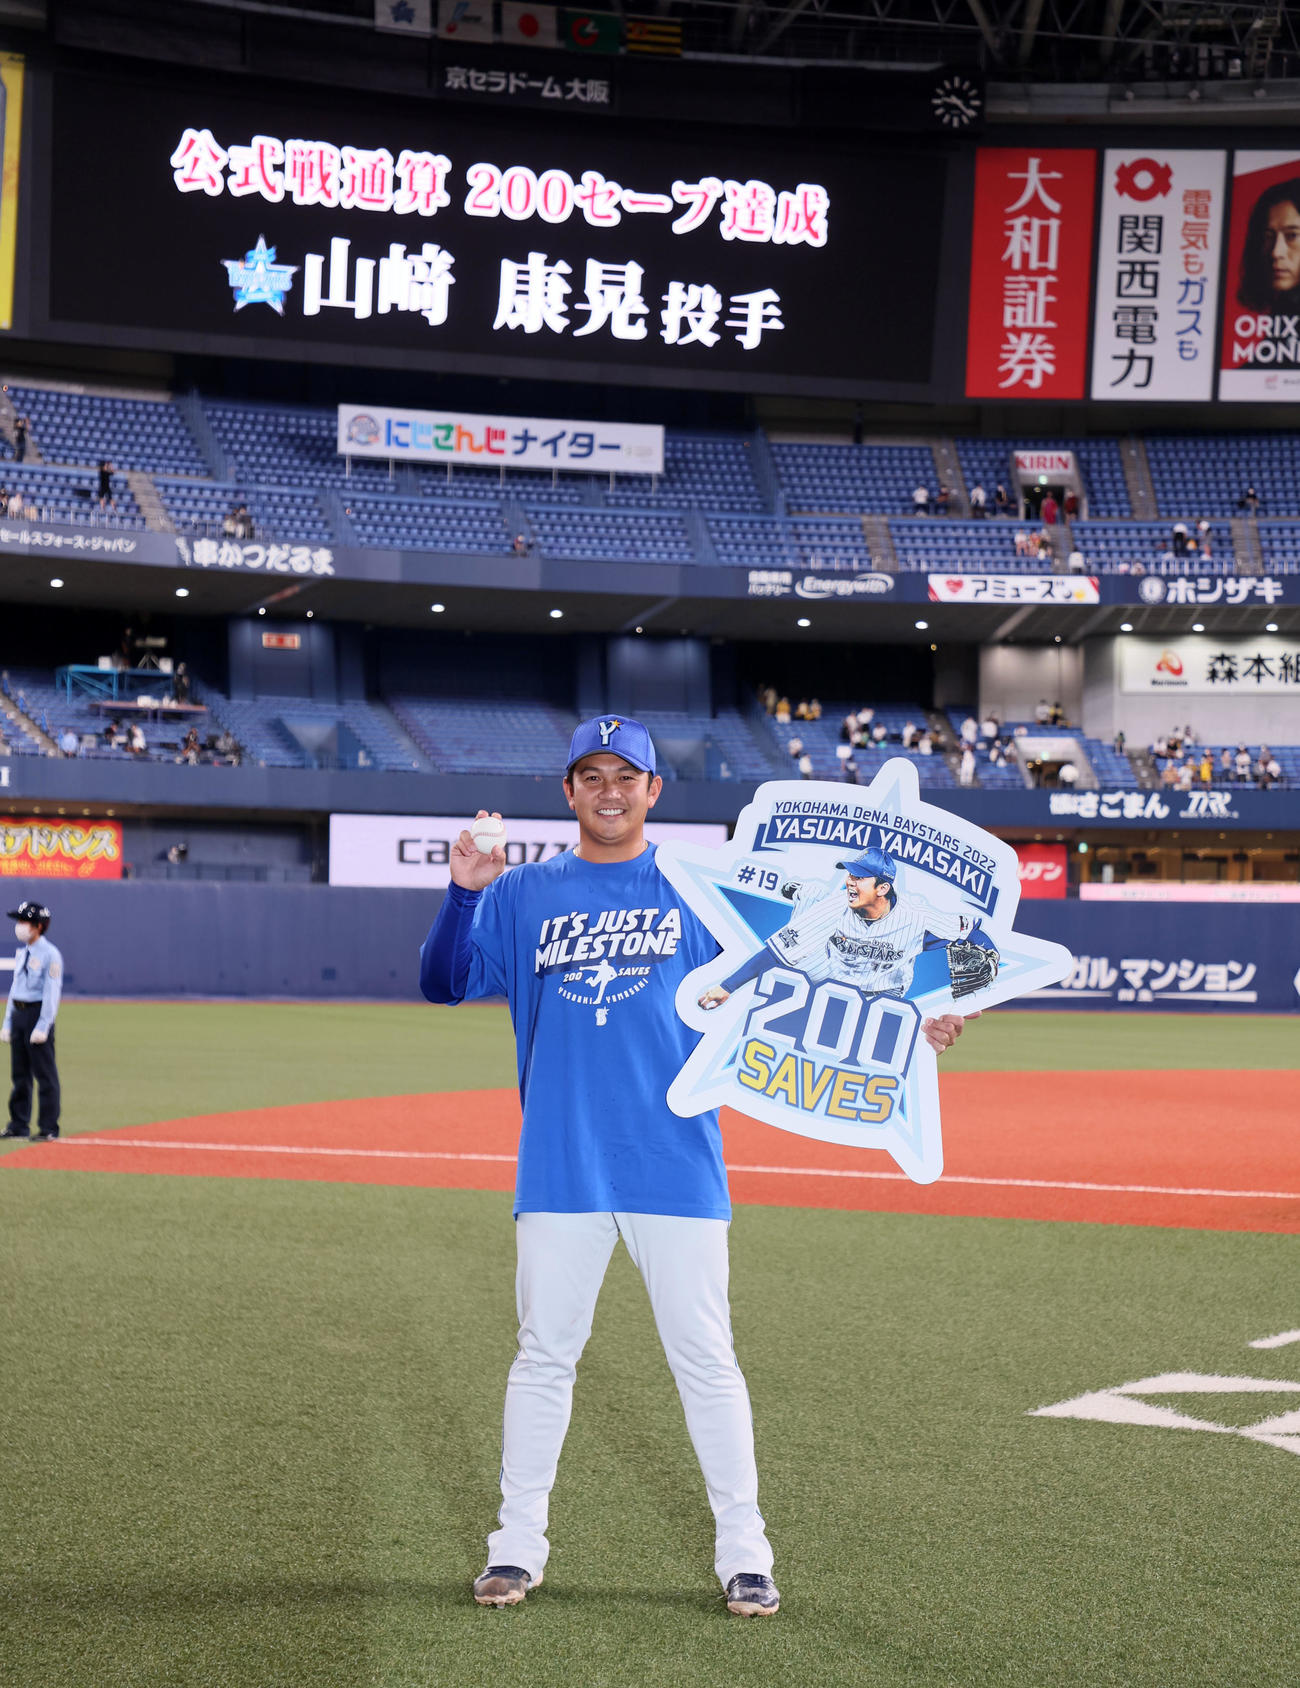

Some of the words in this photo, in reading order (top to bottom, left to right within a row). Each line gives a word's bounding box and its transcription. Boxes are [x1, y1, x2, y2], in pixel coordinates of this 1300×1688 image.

[445, 67, 610, 103] 京セラドーム大阪
[170, 128, 452, 217] 公式戦通算
[464, 162, 829, 247] 200セーブ達成
[493, 251, 650, 340] 康晃
[660, 281, 785, 350] 投手
[997, 157, 1062, 388] 大和証券
[1110, 214, 1164, 388] 関西電力
[1176, 189, 1211, 361] 電気もガスも
[1233, 340, 1300, 363] MON
[1235, 314, 1300, 338] ORIX
[1015, 456, 1070, 469] KIRIN
[1167, 577, 1284, 604] ホシザキ
[775, 801, 849, 817] YOKOHAMA
[853, 806, 889, 826] DeNA
[893, 816, 960, 851] BAYSTARS
[963, 845, 997, 874] 2022
[775, 818, 872, 847] YASUAKI
[879, 828, 987, 896] YAMASAKI
[535, 931, 681, 974] MILESTONE
[539, 911, 589, 946] IT'S
[588, 908, 660, 935] JUST
[657, 908, 682, 940] A
[563, 971, 583, 983] 200
[617, 966, 650, 977] SAVES
[745, 966, 921, 1077] 200
[737, 1037, 899, 1124] SAVES
